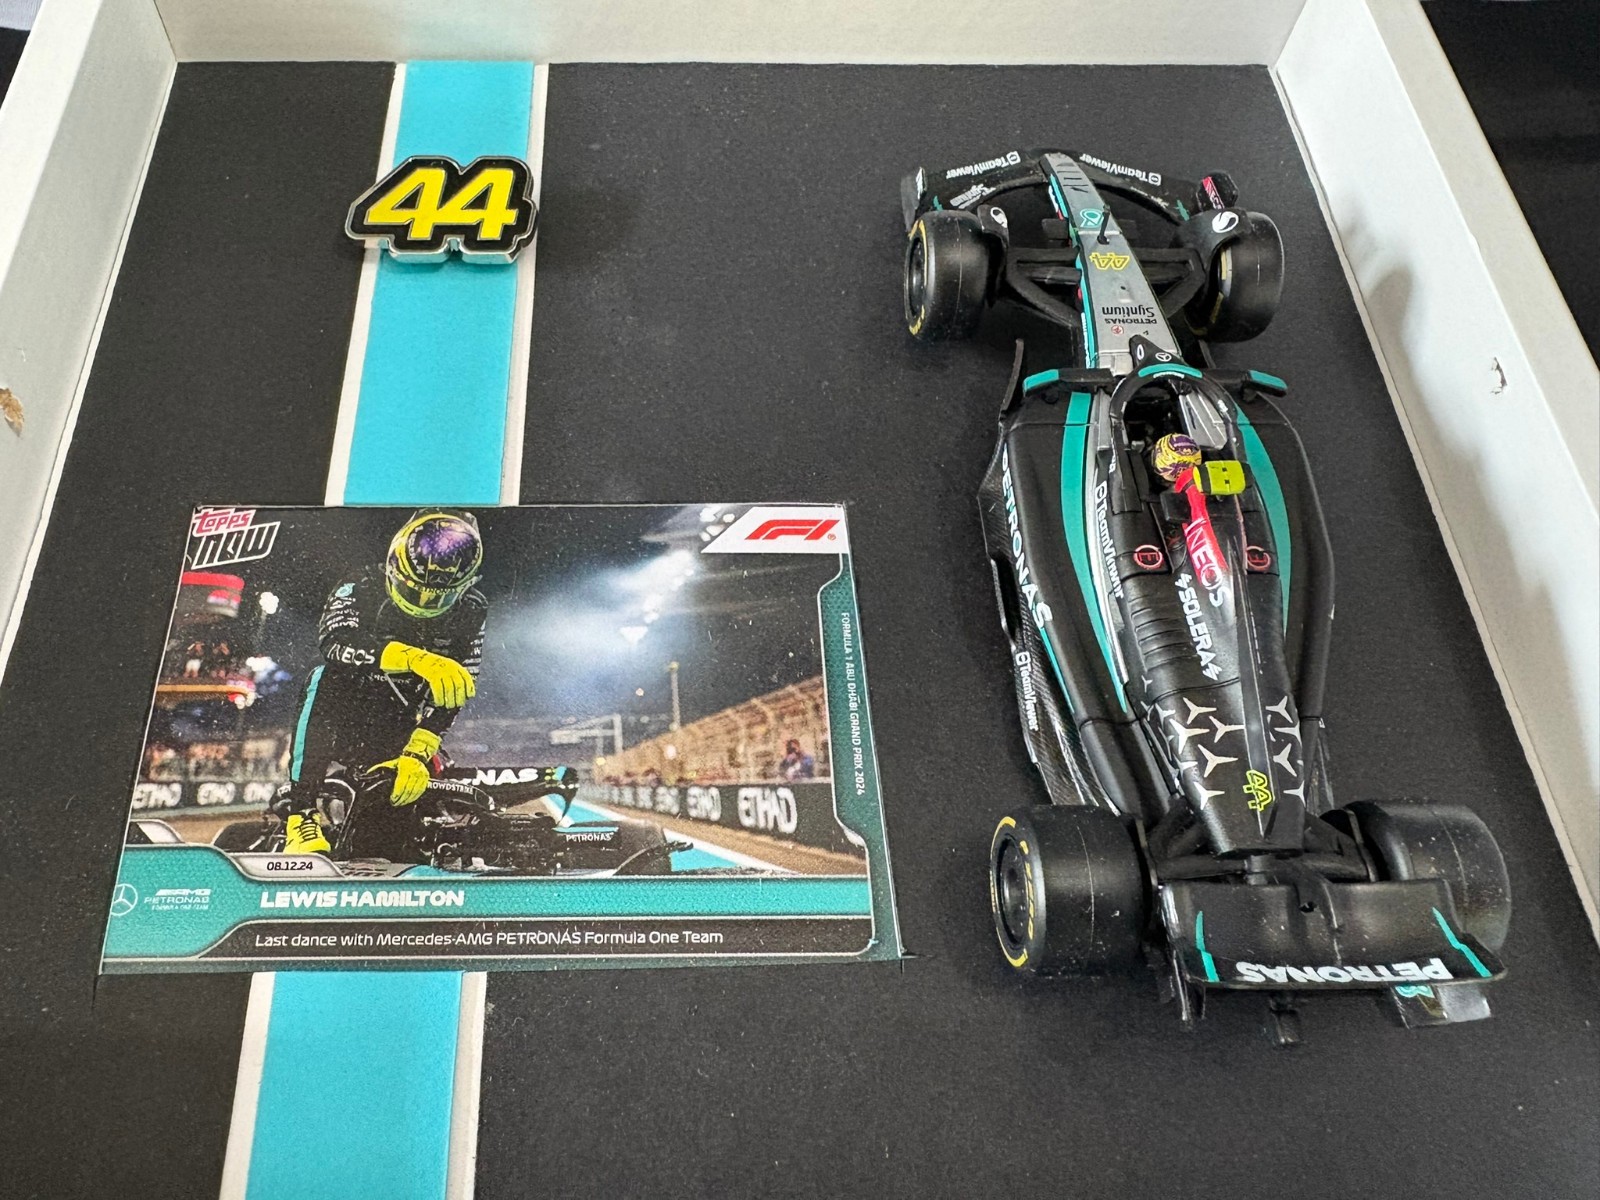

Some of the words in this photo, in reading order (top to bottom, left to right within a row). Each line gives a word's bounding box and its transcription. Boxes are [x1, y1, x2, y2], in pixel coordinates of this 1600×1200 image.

[946, 156, 1010, 179] TeamViewer
[1079, 153, 1149, 182] TeamViewer
[364, 167, 520, 241] 44
[1089, 252, 1131, 271] 44
[1101, 304, 1156, 318] Syntium
[1104, 317, 1158, 326] PETRONAS
[744, 519, 841, 541] F1
[1184, 517, 1232, 608] INEOS
[841, 612, 853, 654] FORMULA
[1178, 587, 1217, 667] SOLERA
[327, 643, 376, 666] INEOS
[845, 662, 856, 681] ABU
[847, 682, 858, 711] DHABI
[1020, 662, 1039, 732] TeamViewer
[849, 712, 862, 746] GRAND
[852, 747, 864, 770] PRIX
[854, 770, 866, 796] 2024
[565, 832, 615, 844] PETRONAS
[266, 860, 314, 872] 08.12.24
[260, 891, 338, 909] LEWIS
[340, 890, 465, 907] HAMILTON
[255, 934, 288, 947] Last
[291, 934, 337, 947] dance
[340, 933, 374, 946] with
[376, 932, 493, 946] Mercedes-AMG
[496, 931, 581, 945] PETRONAS
[584, 931, 646, 944] Formula
[649, 931, 680, 944] One
[682, 931, 724, 944] Team
[1235, 958, 1454, 983] PETRONAS
